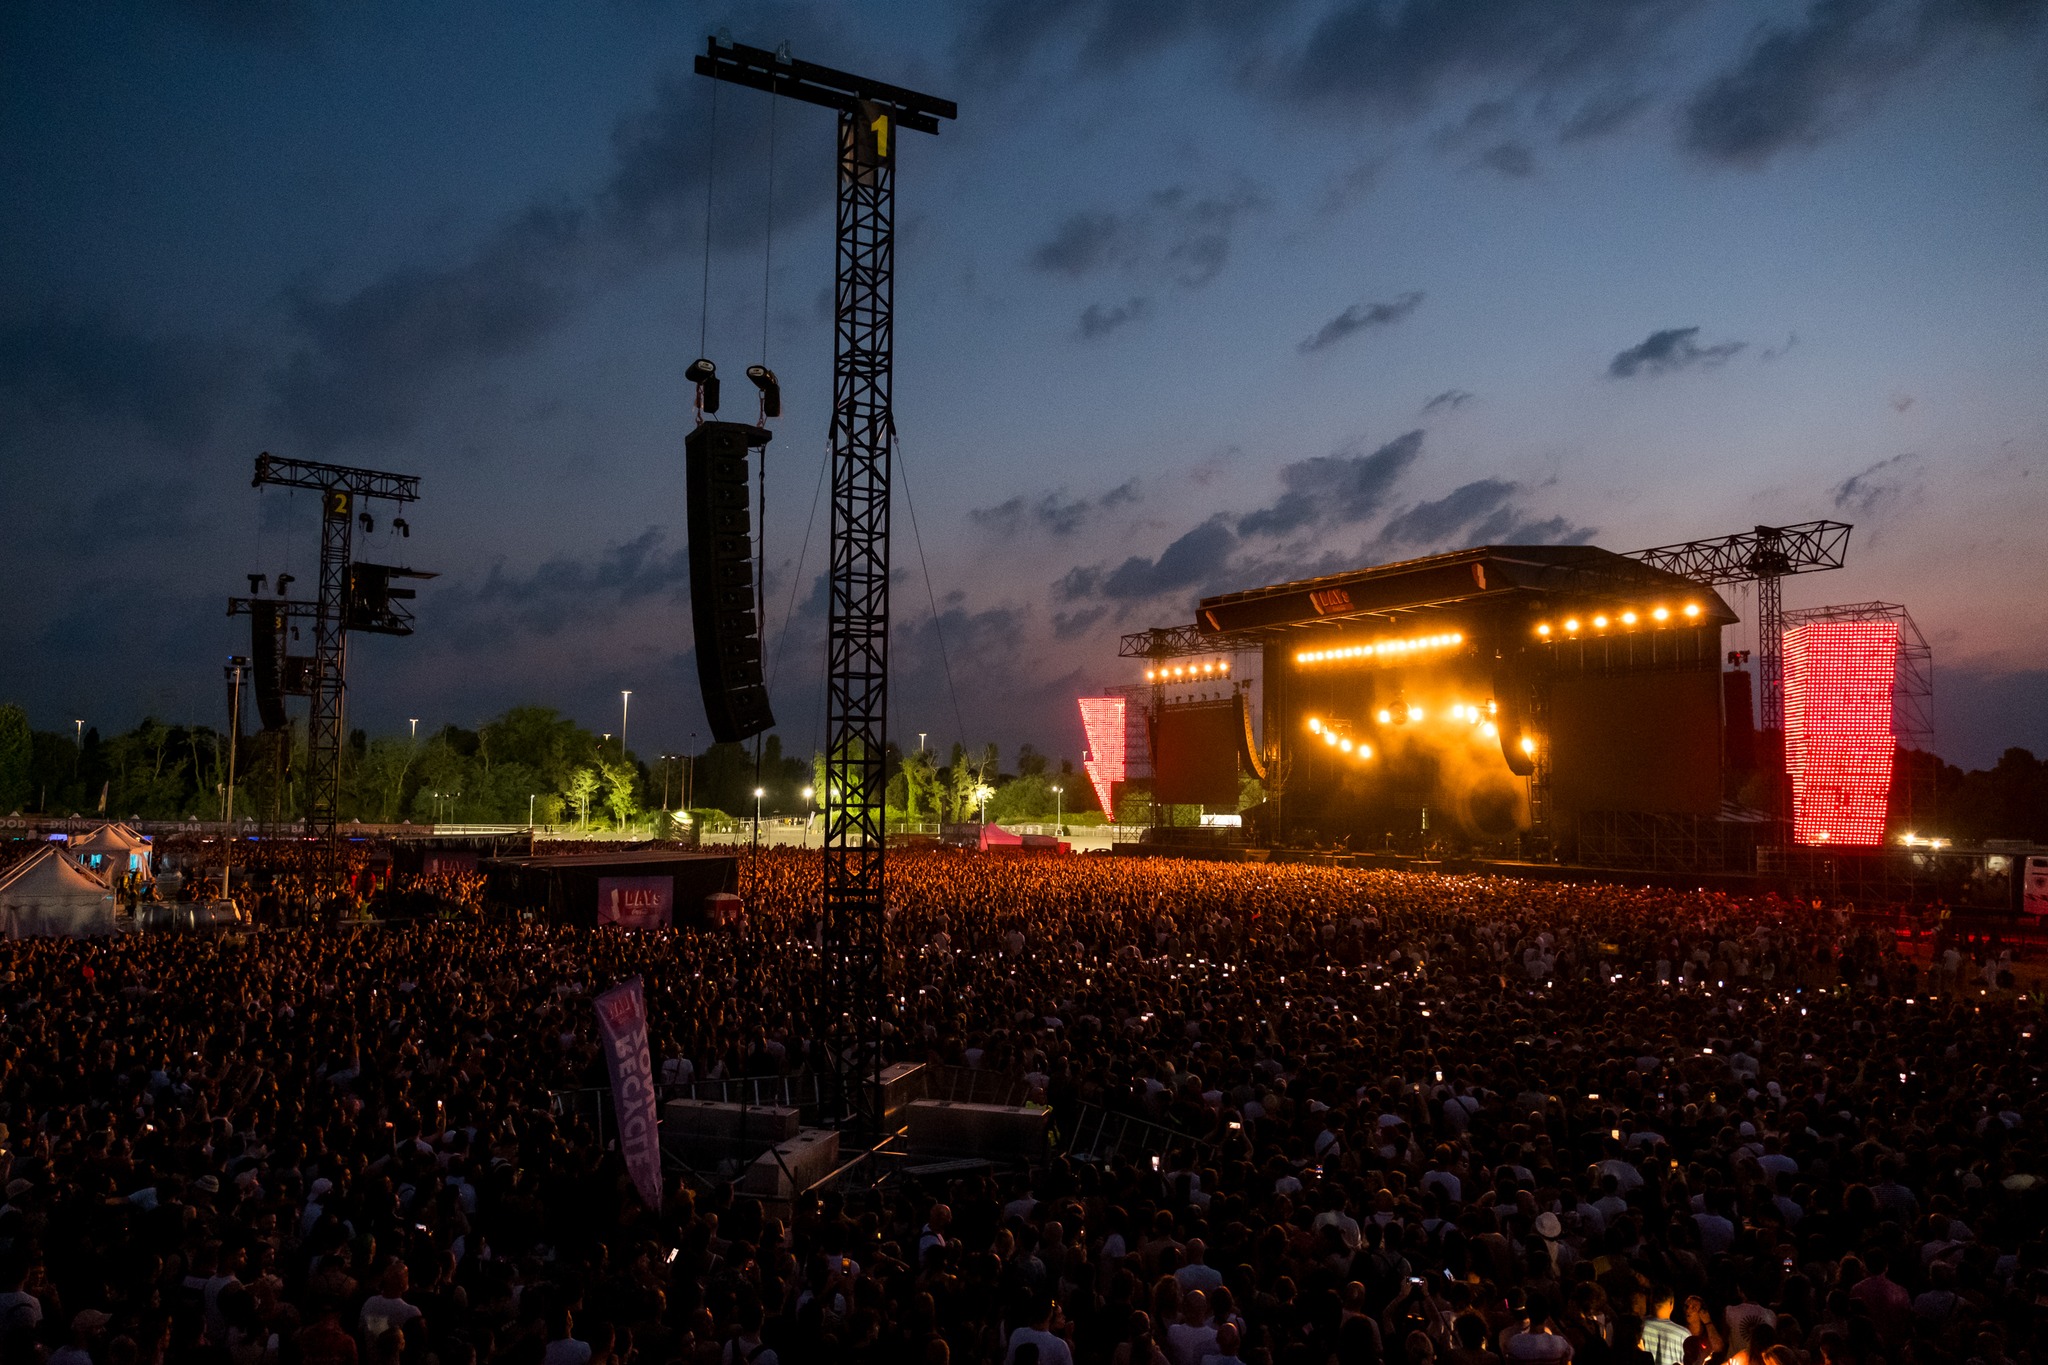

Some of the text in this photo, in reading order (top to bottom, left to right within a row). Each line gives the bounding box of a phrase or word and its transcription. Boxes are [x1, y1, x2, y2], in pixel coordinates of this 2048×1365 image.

[871, 114, 889, 158] 1
[334, 492, 348, 514] 2
[49, 820, 91, 830] DRINK
[178, 822, 202, 832] BAR
